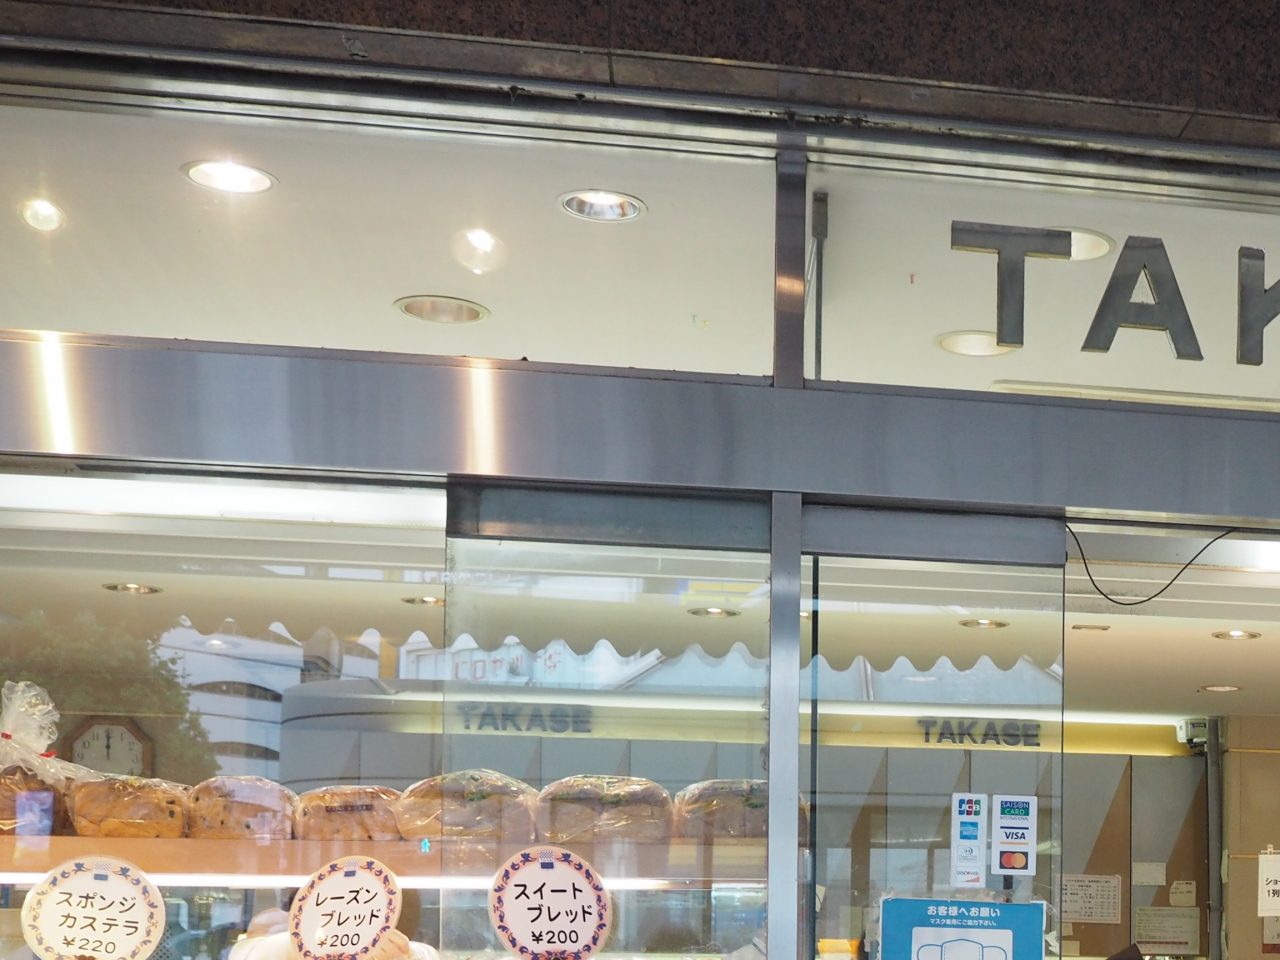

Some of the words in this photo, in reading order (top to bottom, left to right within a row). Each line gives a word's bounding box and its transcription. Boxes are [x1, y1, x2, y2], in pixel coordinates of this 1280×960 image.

[457, 702, 593, 734] TAKASE
[917, 719, 1041, 747] TAKASE
[957, 798, 982, 817] JCB
[1004, 831, 1026, 840] VISA
[315, 887, 379, 908] レーズン
[513, 882, 583, 901] スイート
[56, 891, 137, 914] スポンジ
[927, 905, 1001, 918] お客様へお願い
[319, 909, 382, 928] ブレッド
[527, 904, 593, 924] ブレッド
[58, 913, 140, 936] カステラ
[61, 935, 117, 954] ¥220
[316, 933, 361, 949] ¥200
[530, 929, 580, 945] ¥200
